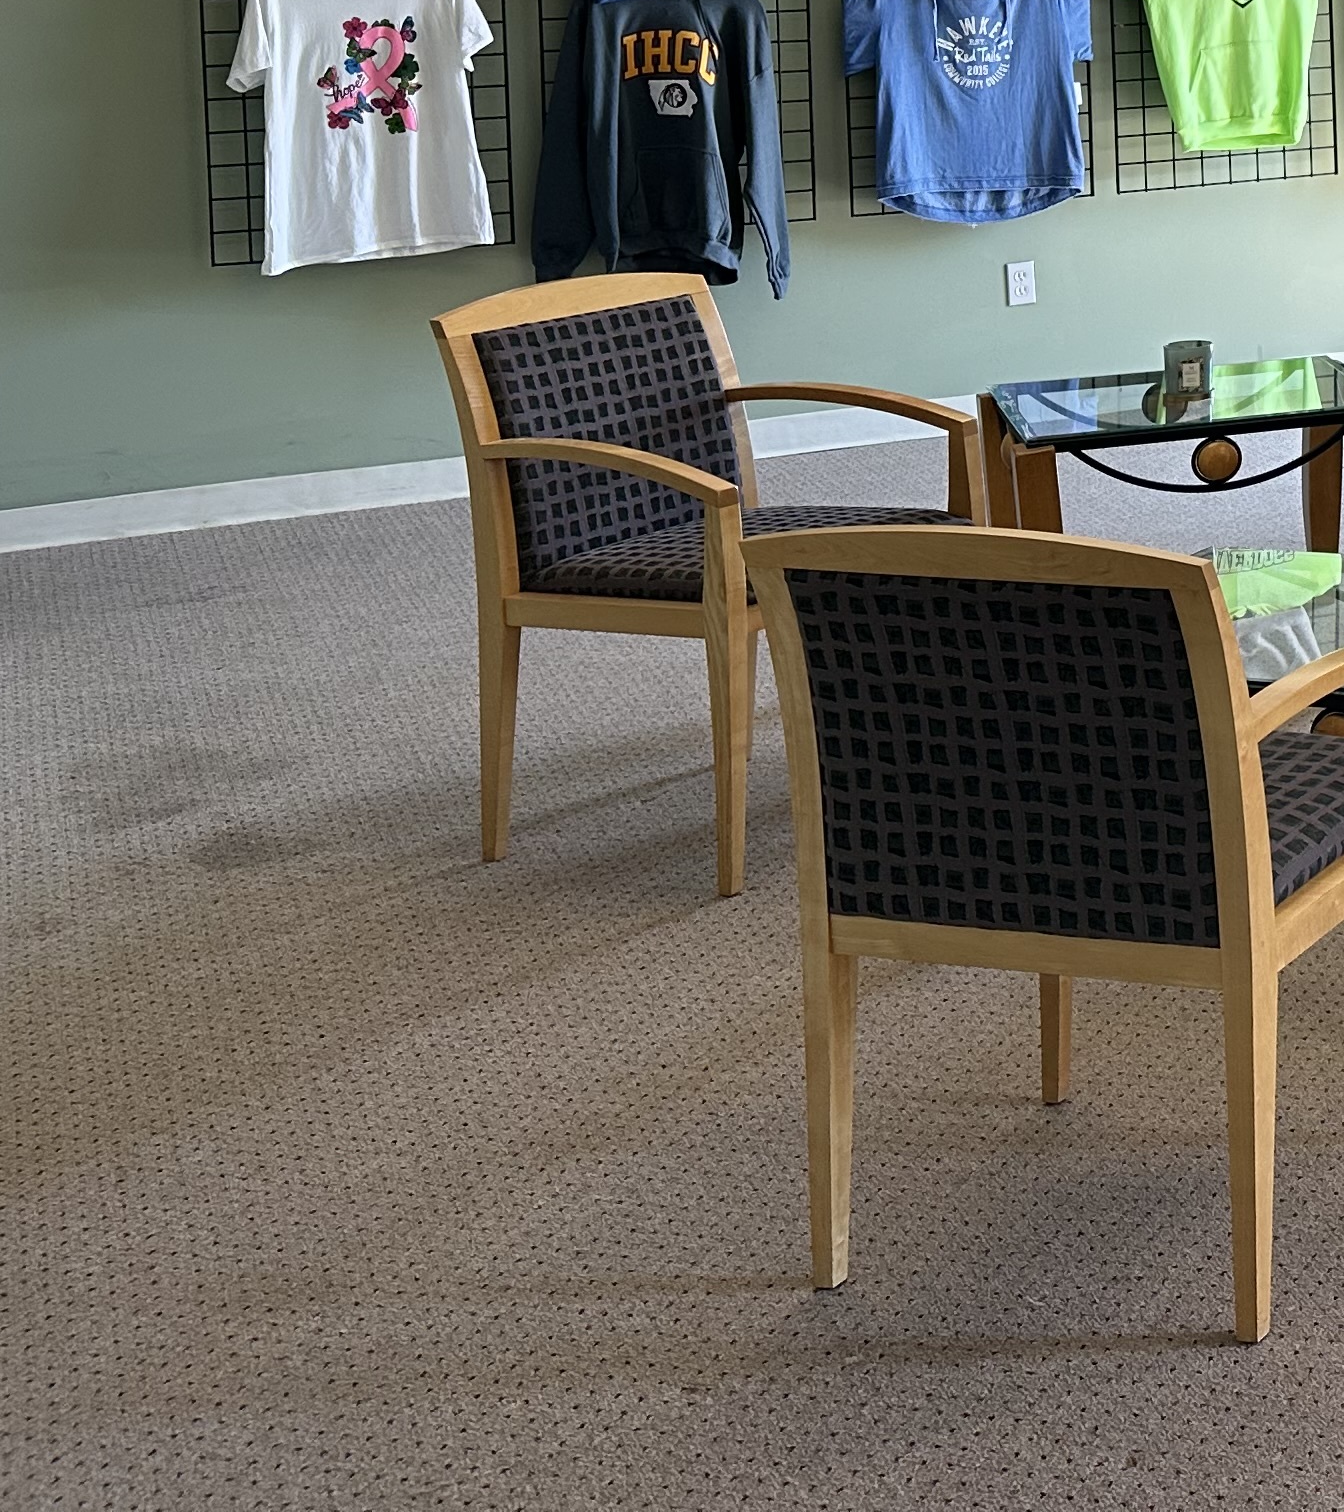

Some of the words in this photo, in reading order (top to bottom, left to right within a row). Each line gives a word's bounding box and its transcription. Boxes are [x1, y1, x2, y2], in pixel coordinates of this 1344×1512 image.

[622, 29, 719, 85] IHCC
[954, 47, 976, 63] Red
[967, 65, 988, 76] 2015
